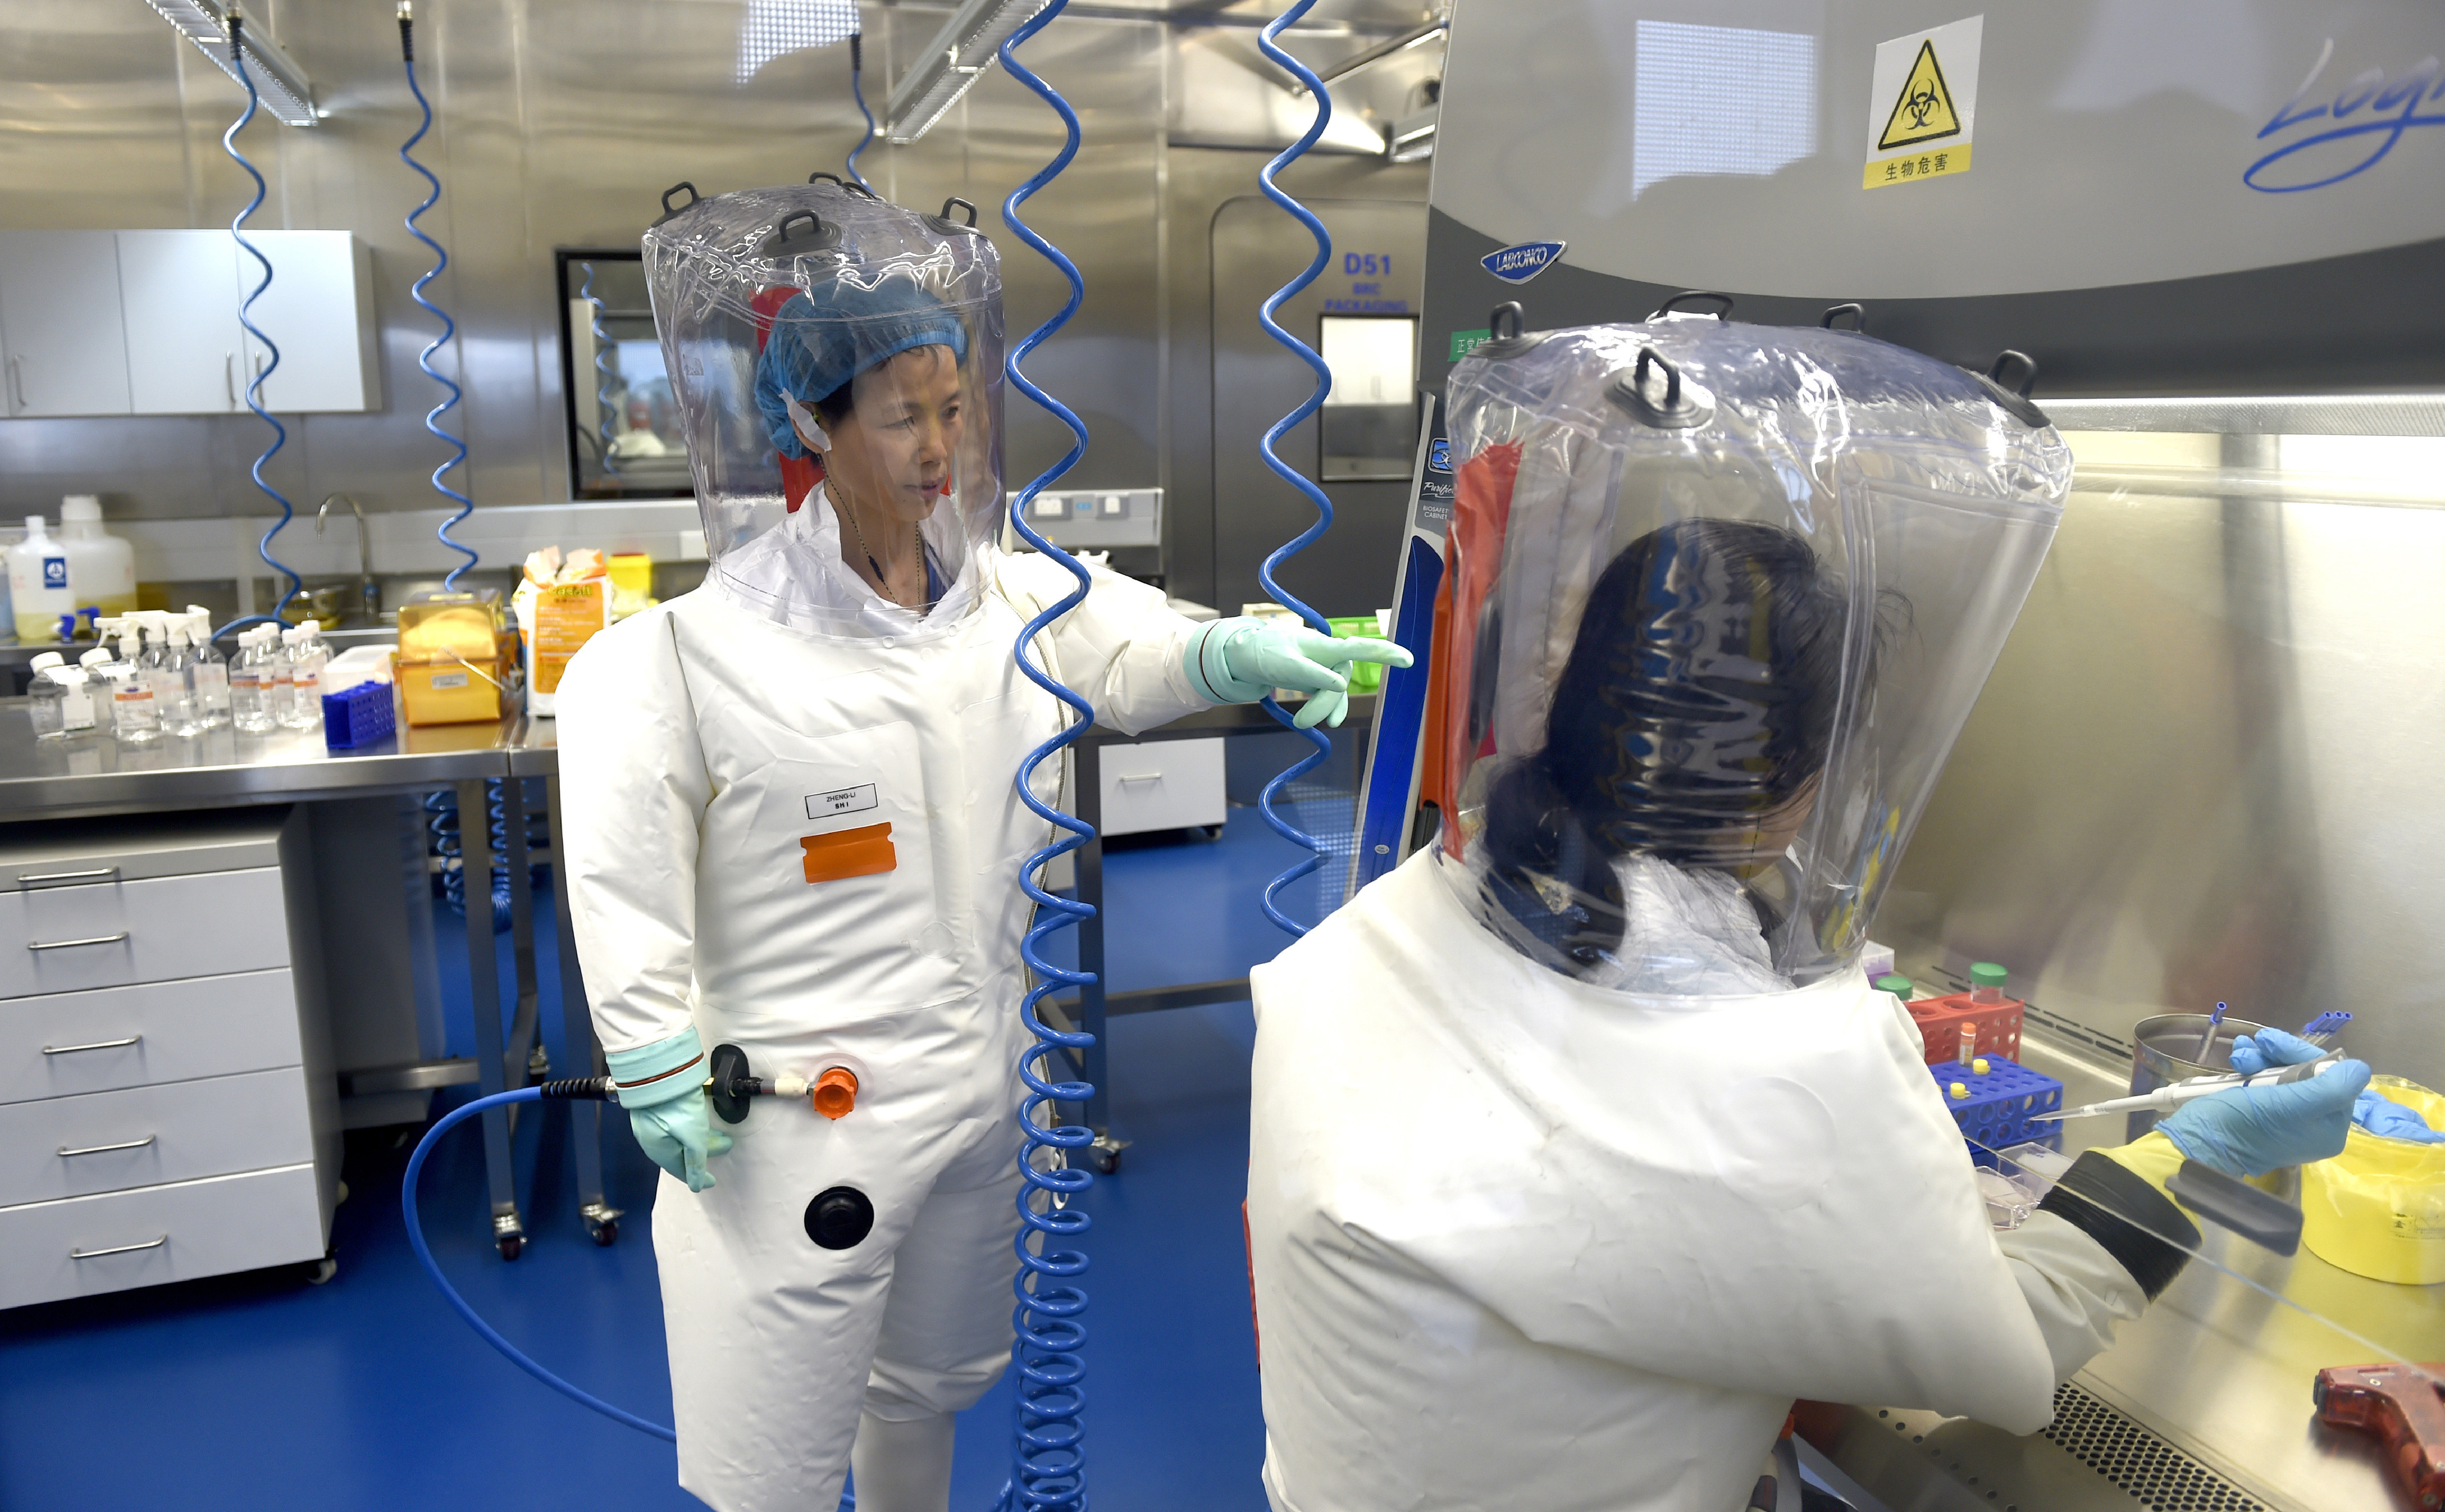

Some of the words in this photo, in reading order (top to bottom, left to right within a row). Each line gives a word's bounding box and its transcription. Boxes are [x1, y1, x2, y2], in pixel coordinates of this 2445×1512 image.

[1885, 153, 1948, 180] 生物危害
[1345, 253, 1391, 276] D51
[1496, 246, 1547, 272] LABCONCO
[1325, 298, 1408, 312] PACKAGING
[1457, 337, 1492, 353] 正常
[1424, 511, 1447, 520] CABINET
[826, 792, 856, 802] ZHENG-LI
